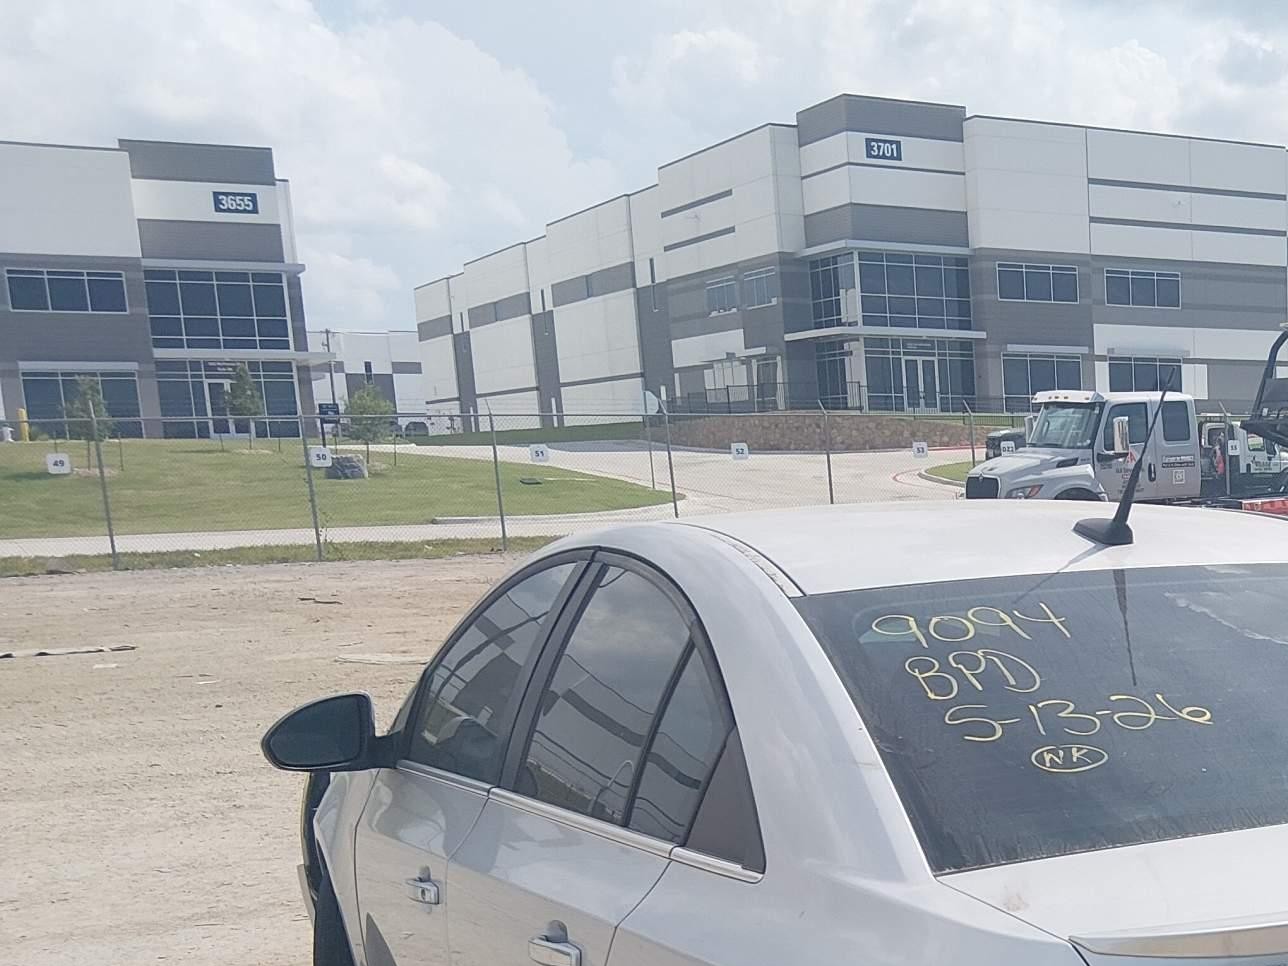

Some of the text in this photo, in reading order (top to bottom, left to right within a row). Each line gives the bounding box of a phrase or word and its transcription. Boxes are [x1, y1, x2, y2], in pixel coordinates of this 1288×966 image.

[870, 141, 897, 157] 3701
[218, 195, 253, 210] 3655
[315, 453, 327, 461] 50
[735, 447, 745, 455] 52
[53, 459, 65, 467] 49
[872, 602, 1071, 648] 9094
[905, 649, 1040, 700] BPD
[945, 693, 1213, 742] 5-13-26
